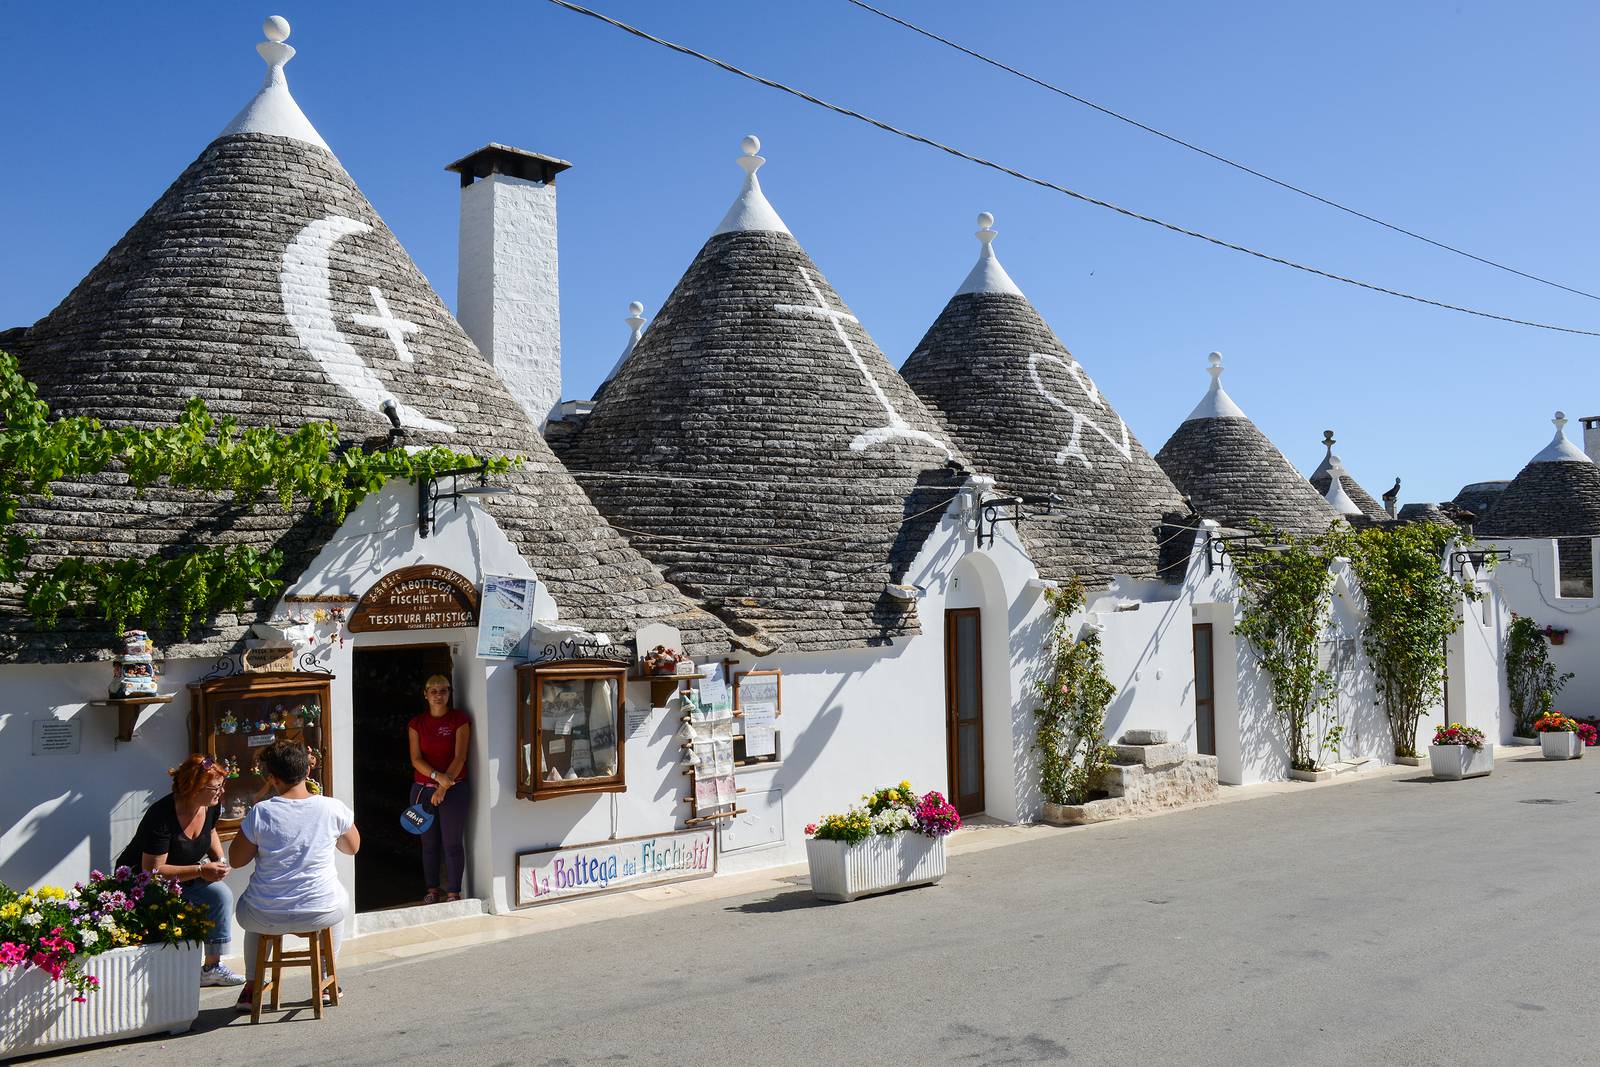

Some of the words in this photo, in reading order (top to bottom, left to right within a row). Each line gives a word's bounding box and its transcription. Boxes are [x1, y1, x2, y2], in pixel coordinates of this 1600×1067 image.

[390, 594, 452, 605] FISCHIETTI
[369, 613, 421, 625] TESSITURA
[425, 611, 473, 623] ARTISTICA
[531, 868, 550, 897] La
[553, 853, 618, 889] Bottega
[623, 857, 637, 876] dei
[641, 836, 711, 873] Fischietti
